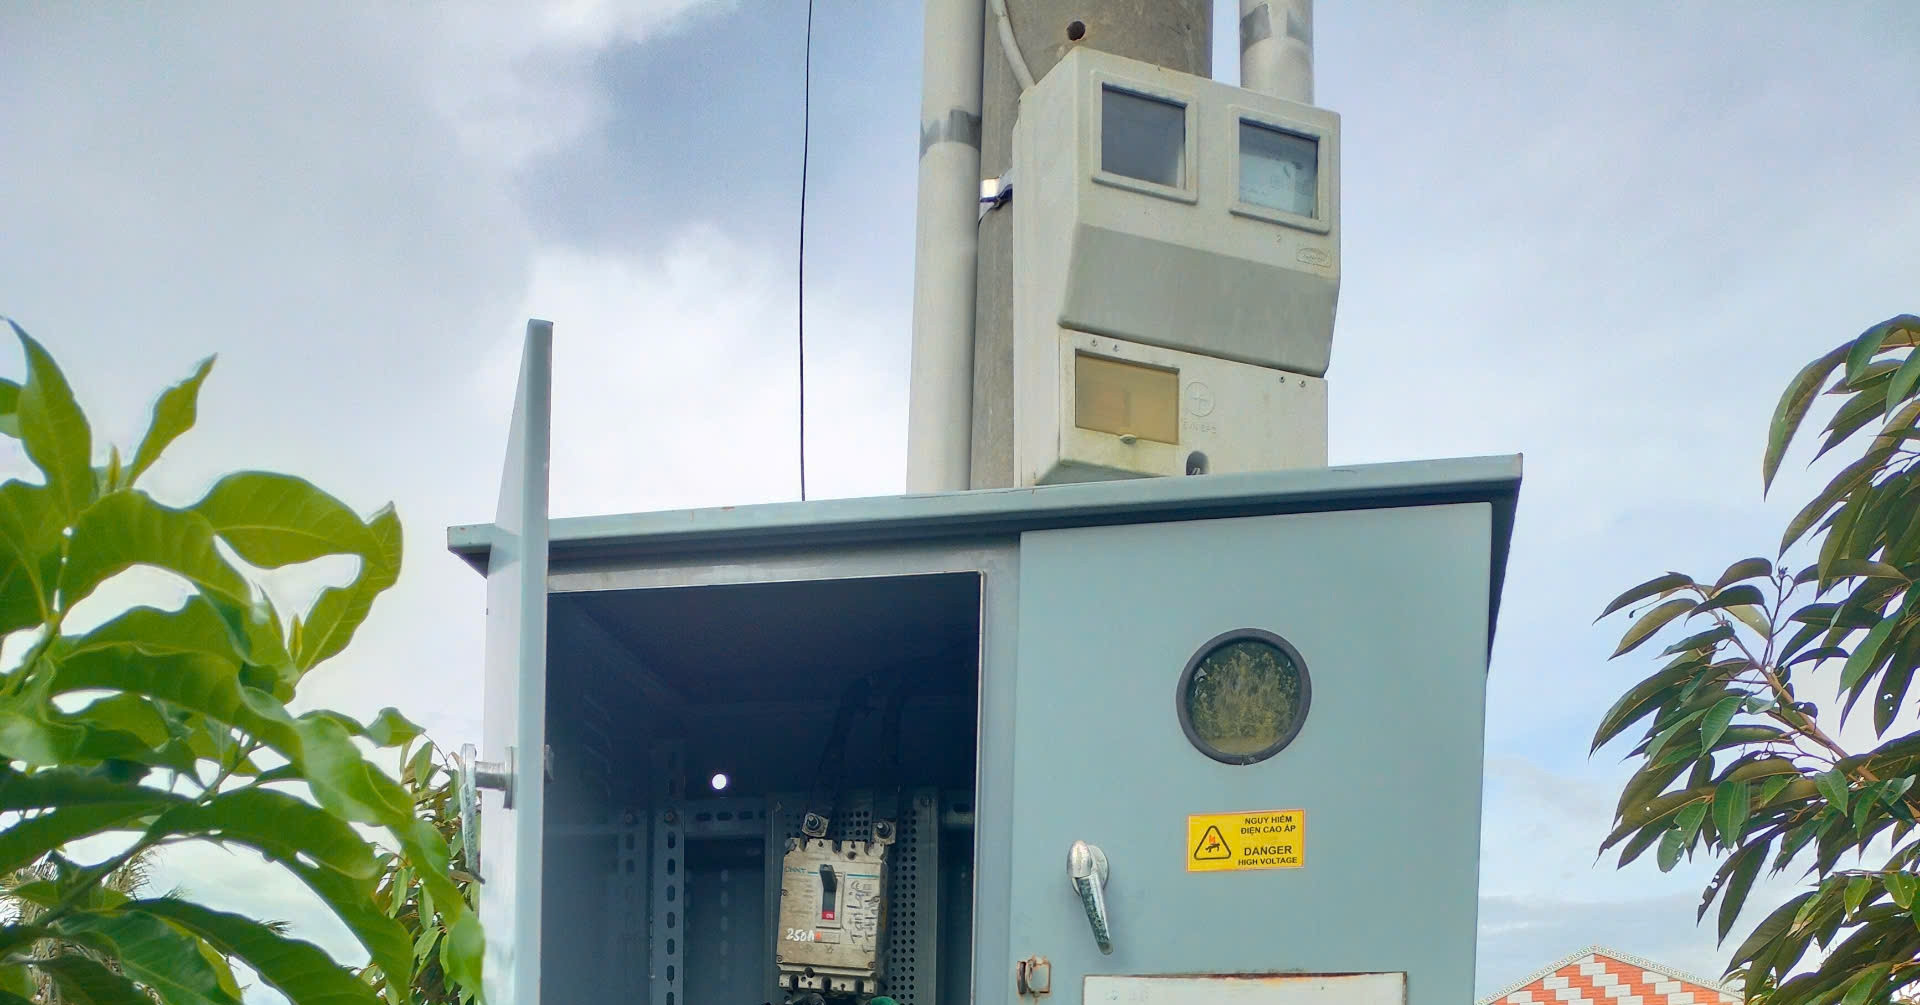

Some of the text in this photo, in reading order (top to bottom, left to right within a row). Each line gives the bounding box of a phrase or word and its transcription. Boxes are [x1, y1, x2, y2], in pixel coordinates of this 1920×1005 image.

[1263, 825, 1282, 833] CAO
[1244, 845, 1292, 856] DANGER
[1238, 857, 1297, 866] HIGH VOLTAGE
